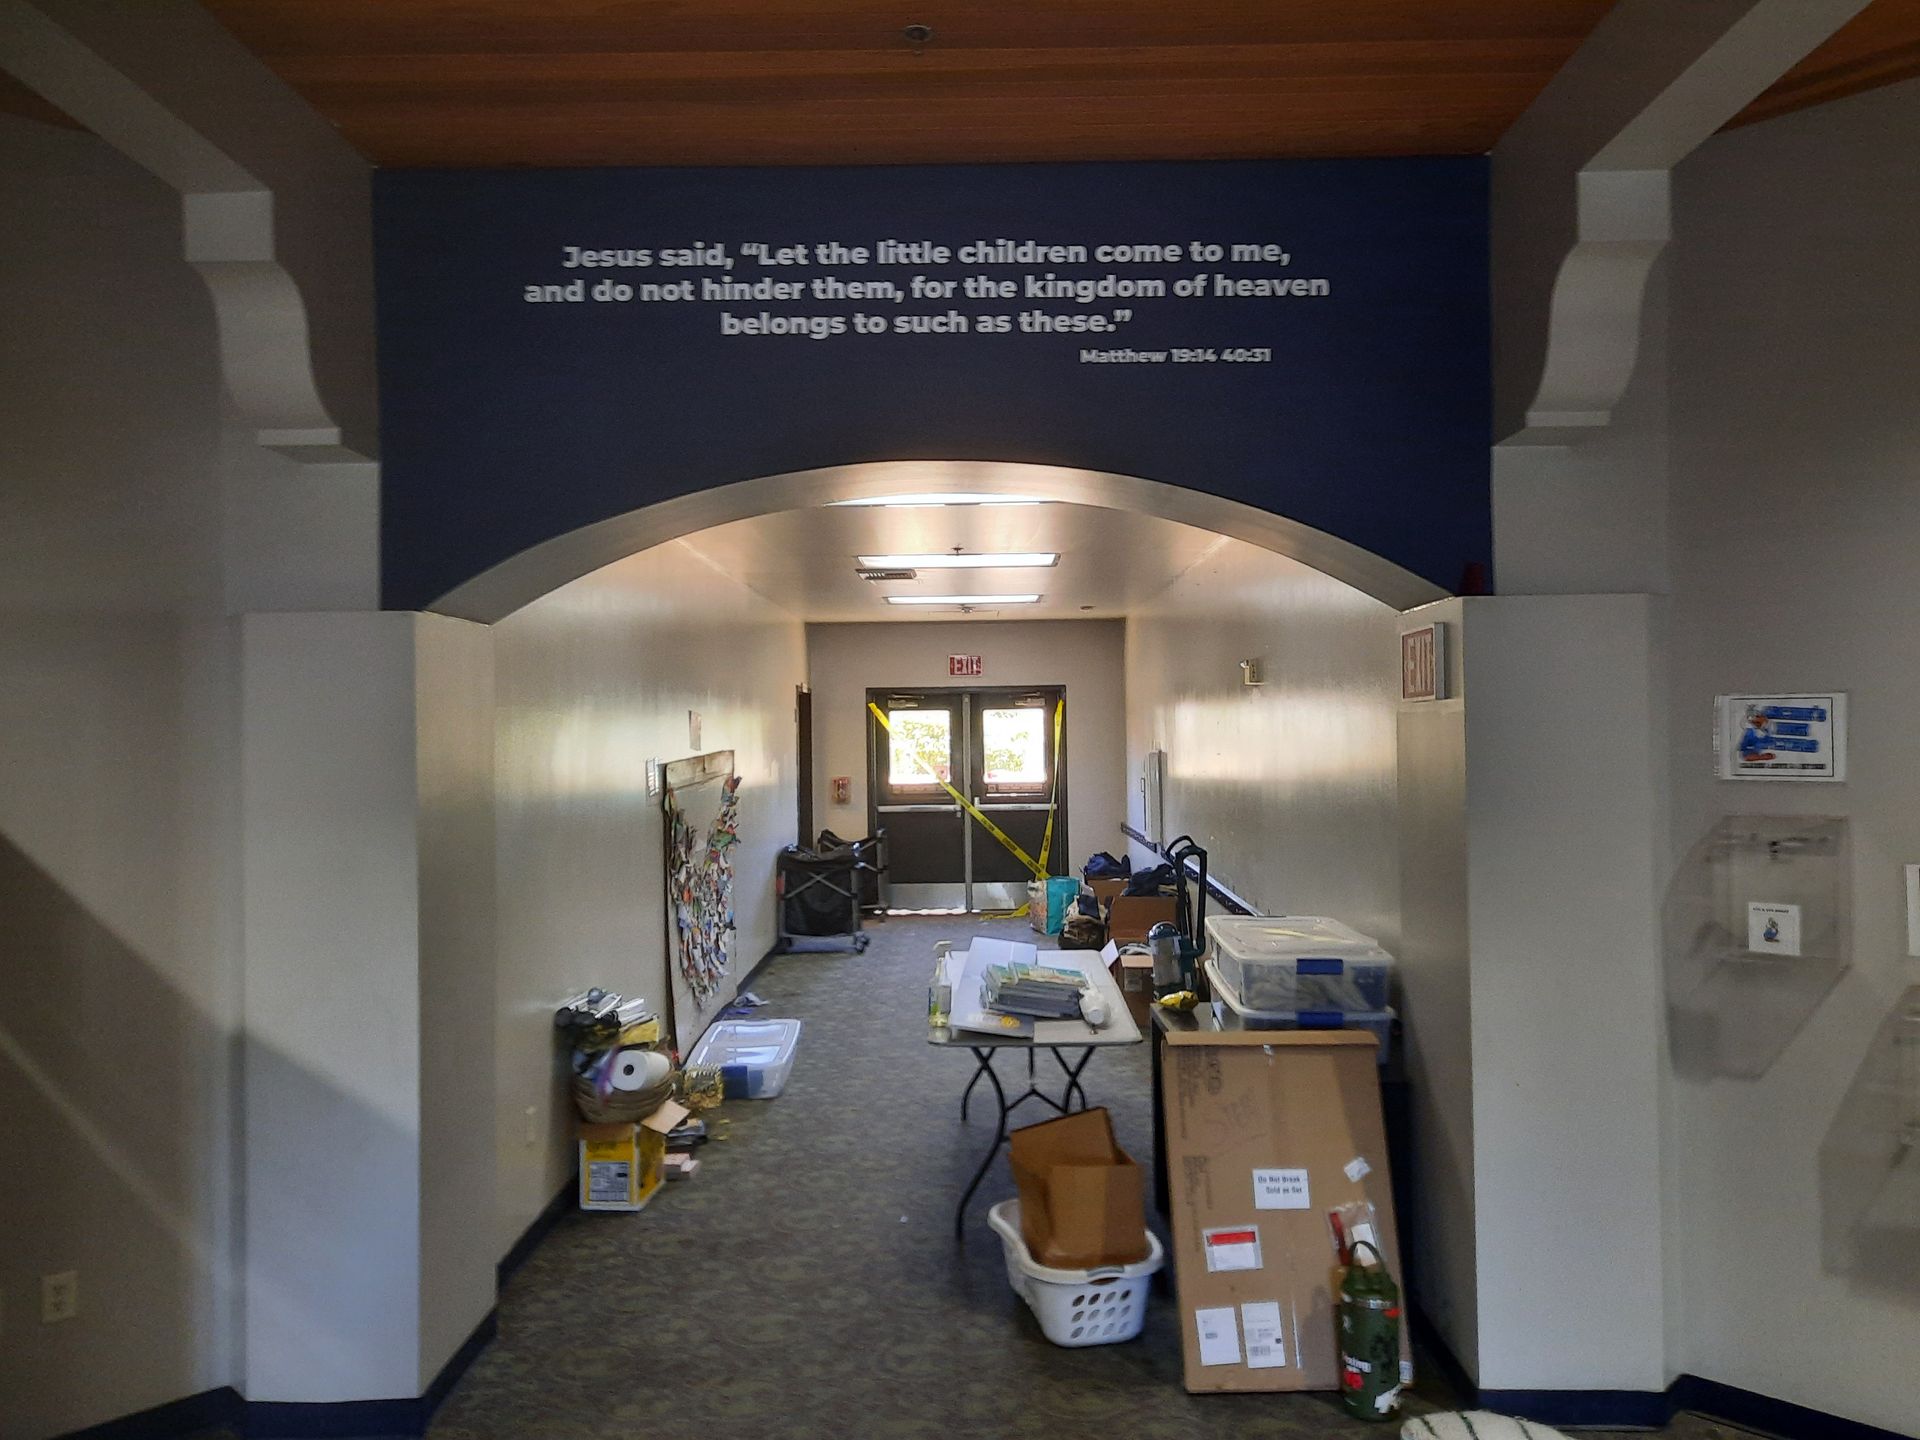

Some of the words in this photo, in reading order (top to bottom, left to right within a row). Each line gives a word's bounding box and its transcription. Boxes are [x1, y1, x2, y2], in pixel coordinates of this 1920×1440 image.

[563, 246, 653, 268] Jesus
[659, 242, 734, 270] said,
[815, 241, 869, 265] the
[876, 240, 951, 264] little
[957, 239, 1088, 264] children
[1095, 245, 1182, 263] come
[1189, 242, 1224, 262] to
[1231, 244, 1290, 265] me,
[523, 280, 585, 302] and
[591, 279, 633, 302] do
[639, 281, 695, 301] not
[701, 276, 805, 300] hinder
[811, 277, 904, 303] them,
[910, 276, 957, 299] for
[963, 276, 1018, 298] the
[1024, 273, 1166, 303] kingdom
[1172, 274, 1208, 297] of
[1214, 274, 1330, 297] heaven
[720, 312, 847, 339] belongs
[853, 313, 888, 333] to
[893, 310, 968, 333] such
[975, 315, 1012, 333] as
[1079, 348, 1167, 363] Matthew
[1170, 348, 1217, 363] 19:14
[1221, 348, 1272, 363] 40:31
[954, 655, 979, 675] EXIT
